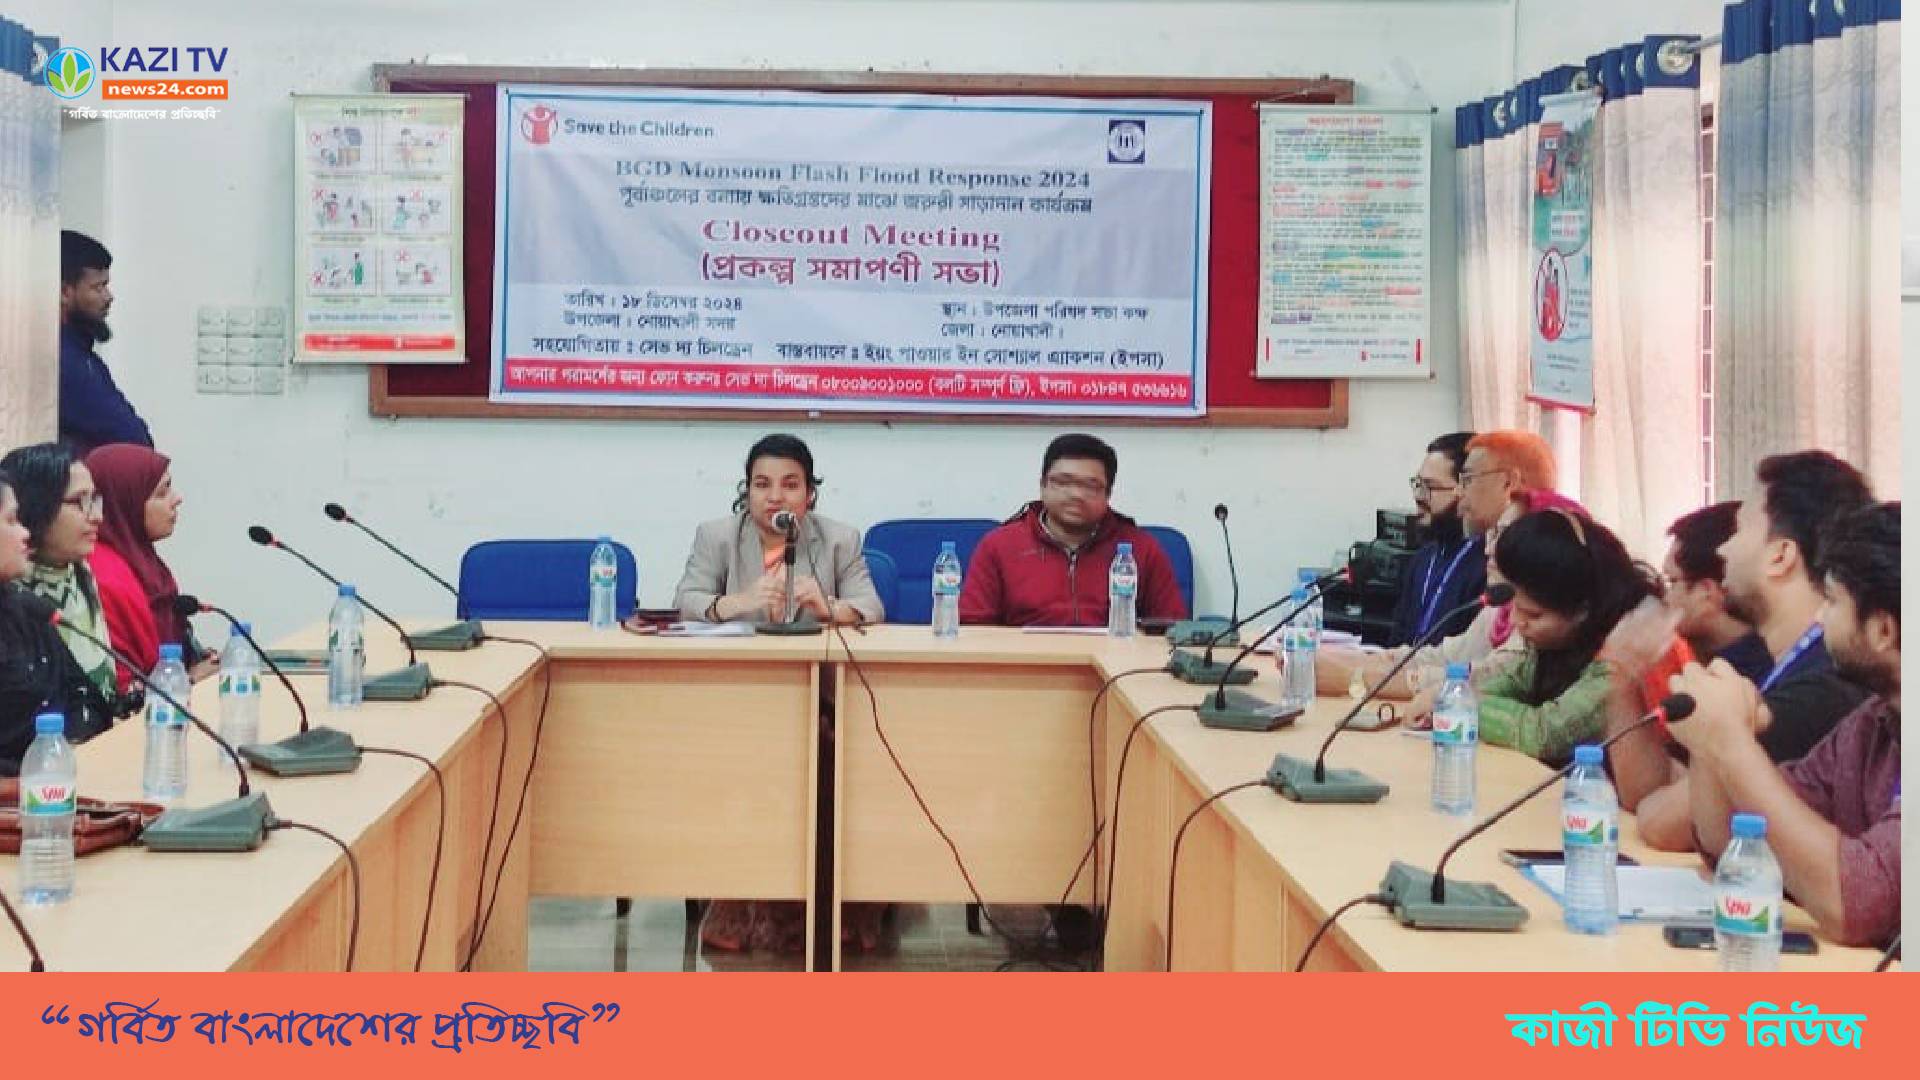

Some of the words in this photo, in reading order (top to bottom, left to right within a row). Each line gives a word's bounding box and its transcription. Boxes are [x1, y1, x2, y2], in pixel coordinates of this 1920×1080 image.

[564, 118, 604, 136] Save
[609, 120, 636, 136] the
[640, 120, 714, 137] Children
[616, 160, 672, 177] BGD
[680, 161, 781, 180] Monsoon
[792, 163, 848, 183] Flash
[859, 165, 920, 184] Flood
[929, 168, 1032, 189] Response
[1039, 170, 1090, 188] 2024
[857, 191, 897, 209] মাঝে
[703, 219, 848, 245] Closeout
[864, 224, 1000, 252] Meeting
[702, 252, 796, 285] (প্রকল্প
[932, 259, 1000, 287] সভা)
[564, 288, 605, 307] তারিখ
[622, 294, 642, 309] ১৮
[647, 290, 698, 309] ডিসেম্বর
[703, 296, 742, 311] ২০২৪
[983, 301, 1038, 319] উপজেলা
[563, 310, 620, 328] উপজেলা
[637, 311, 699, 330] নোয়াখালী
[942, 322, 974, 338] জেলা
[991, 322, 1053, 339] নোয়াখালী
[639, 340, 671, 355] সেভ
[698, 337, 753, 358] চিলড্রেন
[899, 346, 951, 364] পাওয়ার
[1110, 349, 1164, 371] (ইপসা)
